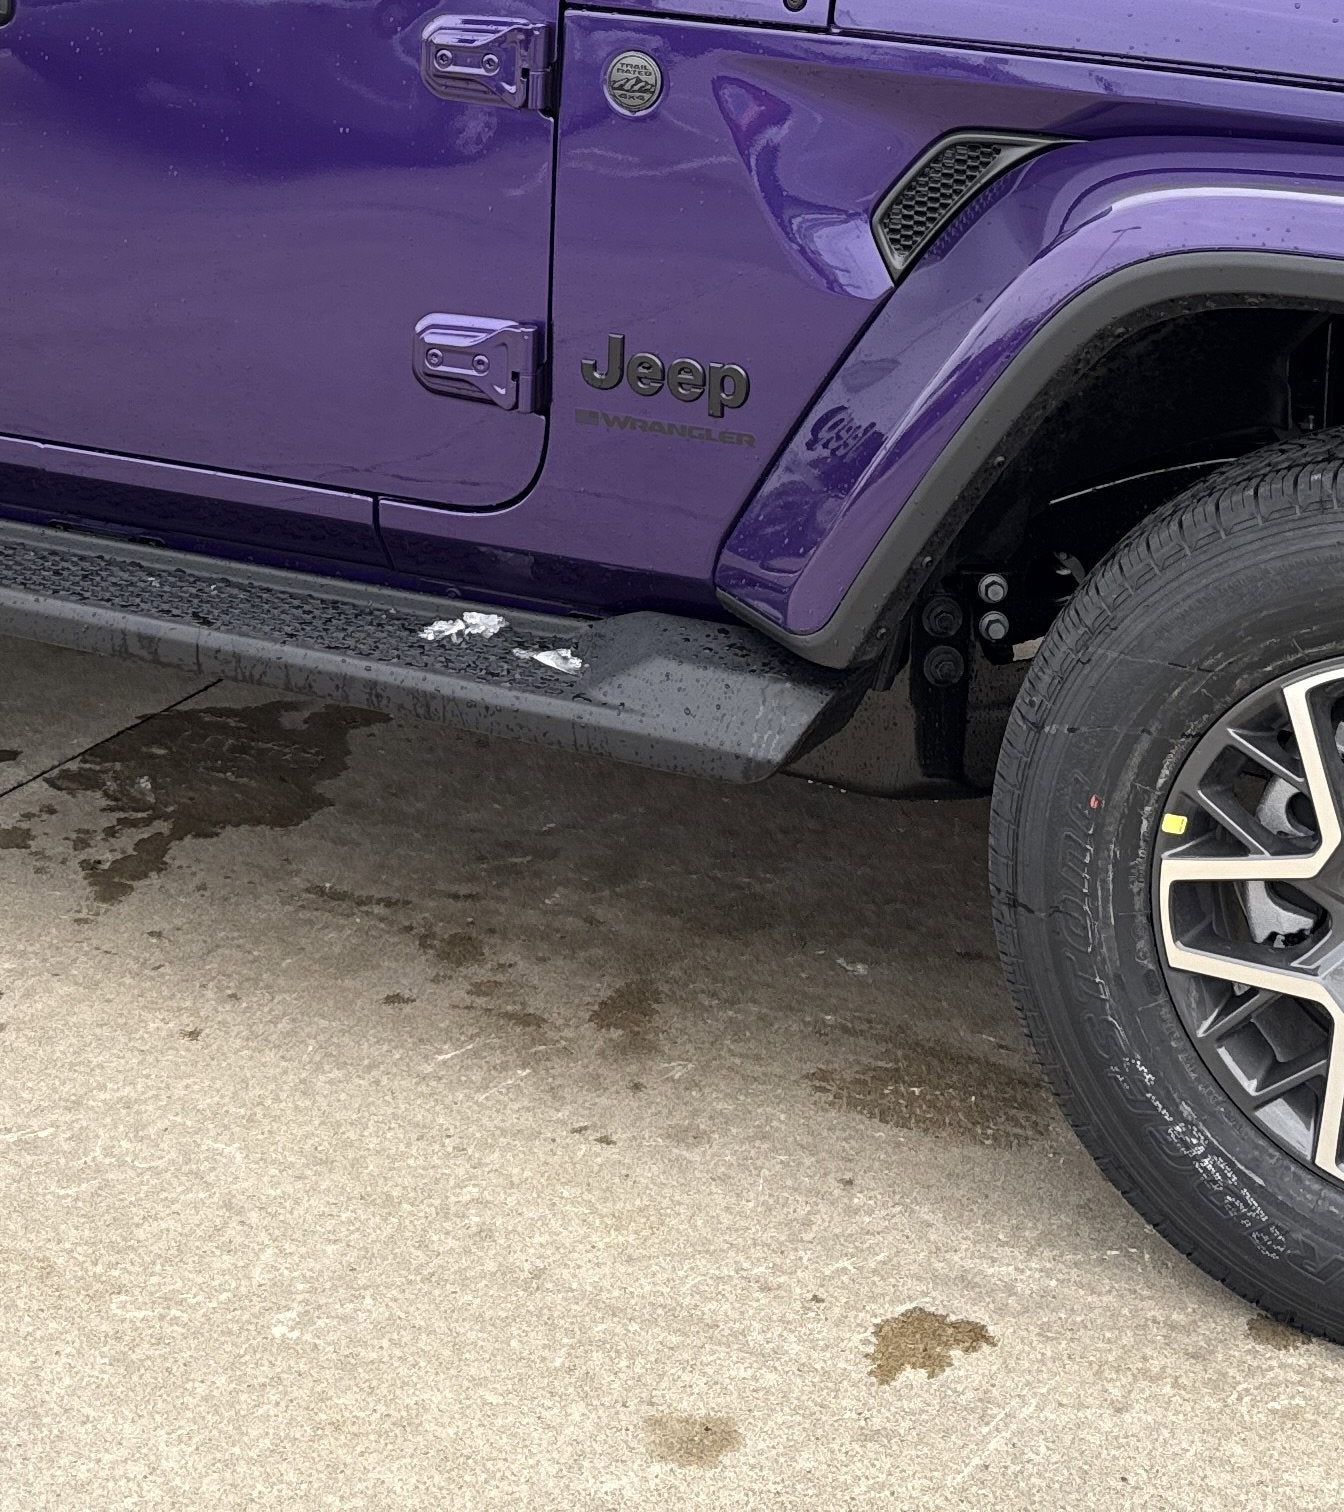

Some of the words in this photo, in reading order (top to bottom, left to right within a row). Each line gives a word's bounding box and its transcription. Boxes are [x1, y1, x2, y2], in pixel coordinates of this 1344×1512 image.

[616, 67, 652, 77] RATED
[620, 62, 649, 71] TRAIL
[580, 333, 750, 419] Jeep
[599, 411, 757, 449] WRANGLER
